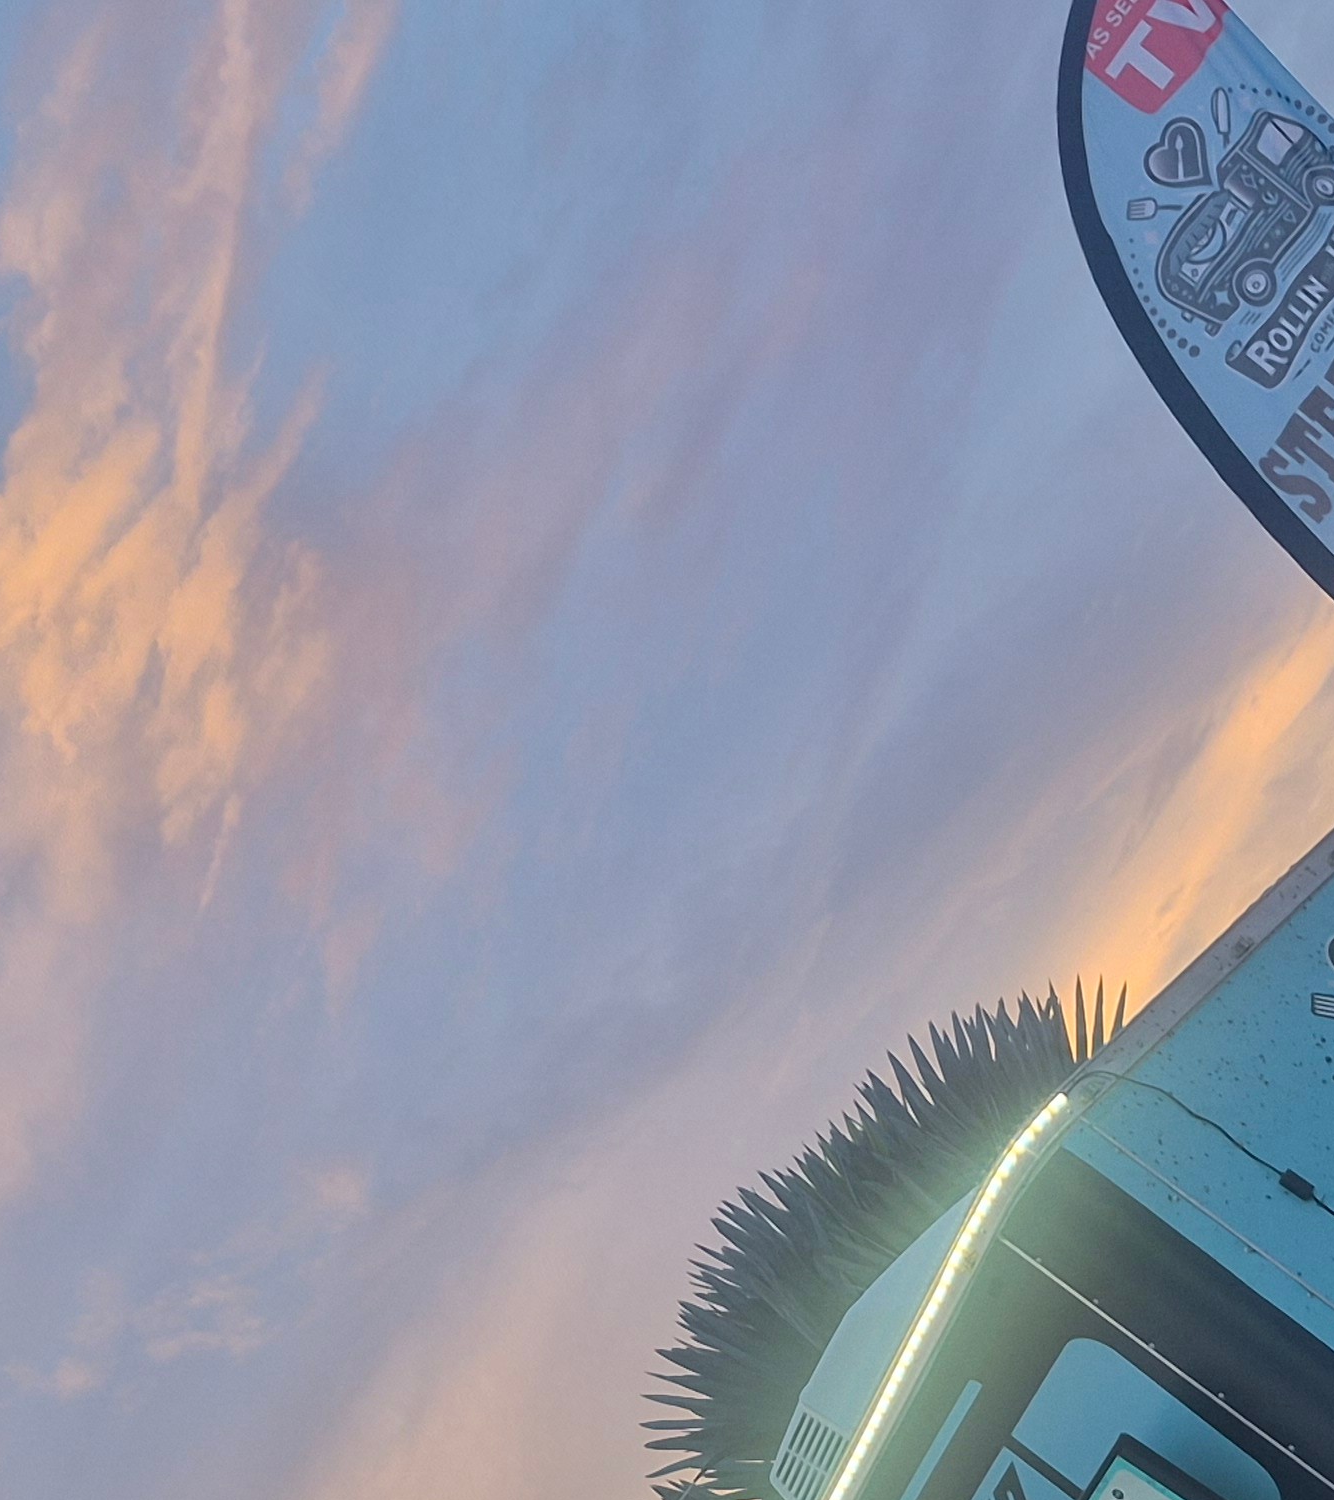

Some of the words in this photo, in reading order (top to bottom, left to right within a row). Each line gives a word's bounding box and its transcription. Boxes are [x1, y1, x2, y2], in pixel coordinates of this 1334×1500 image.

[1086, 27, 1111, 61] AS
[1105, 0, 1217, 91] TV
[1246, 275, 1329, 376] ROLLIN
